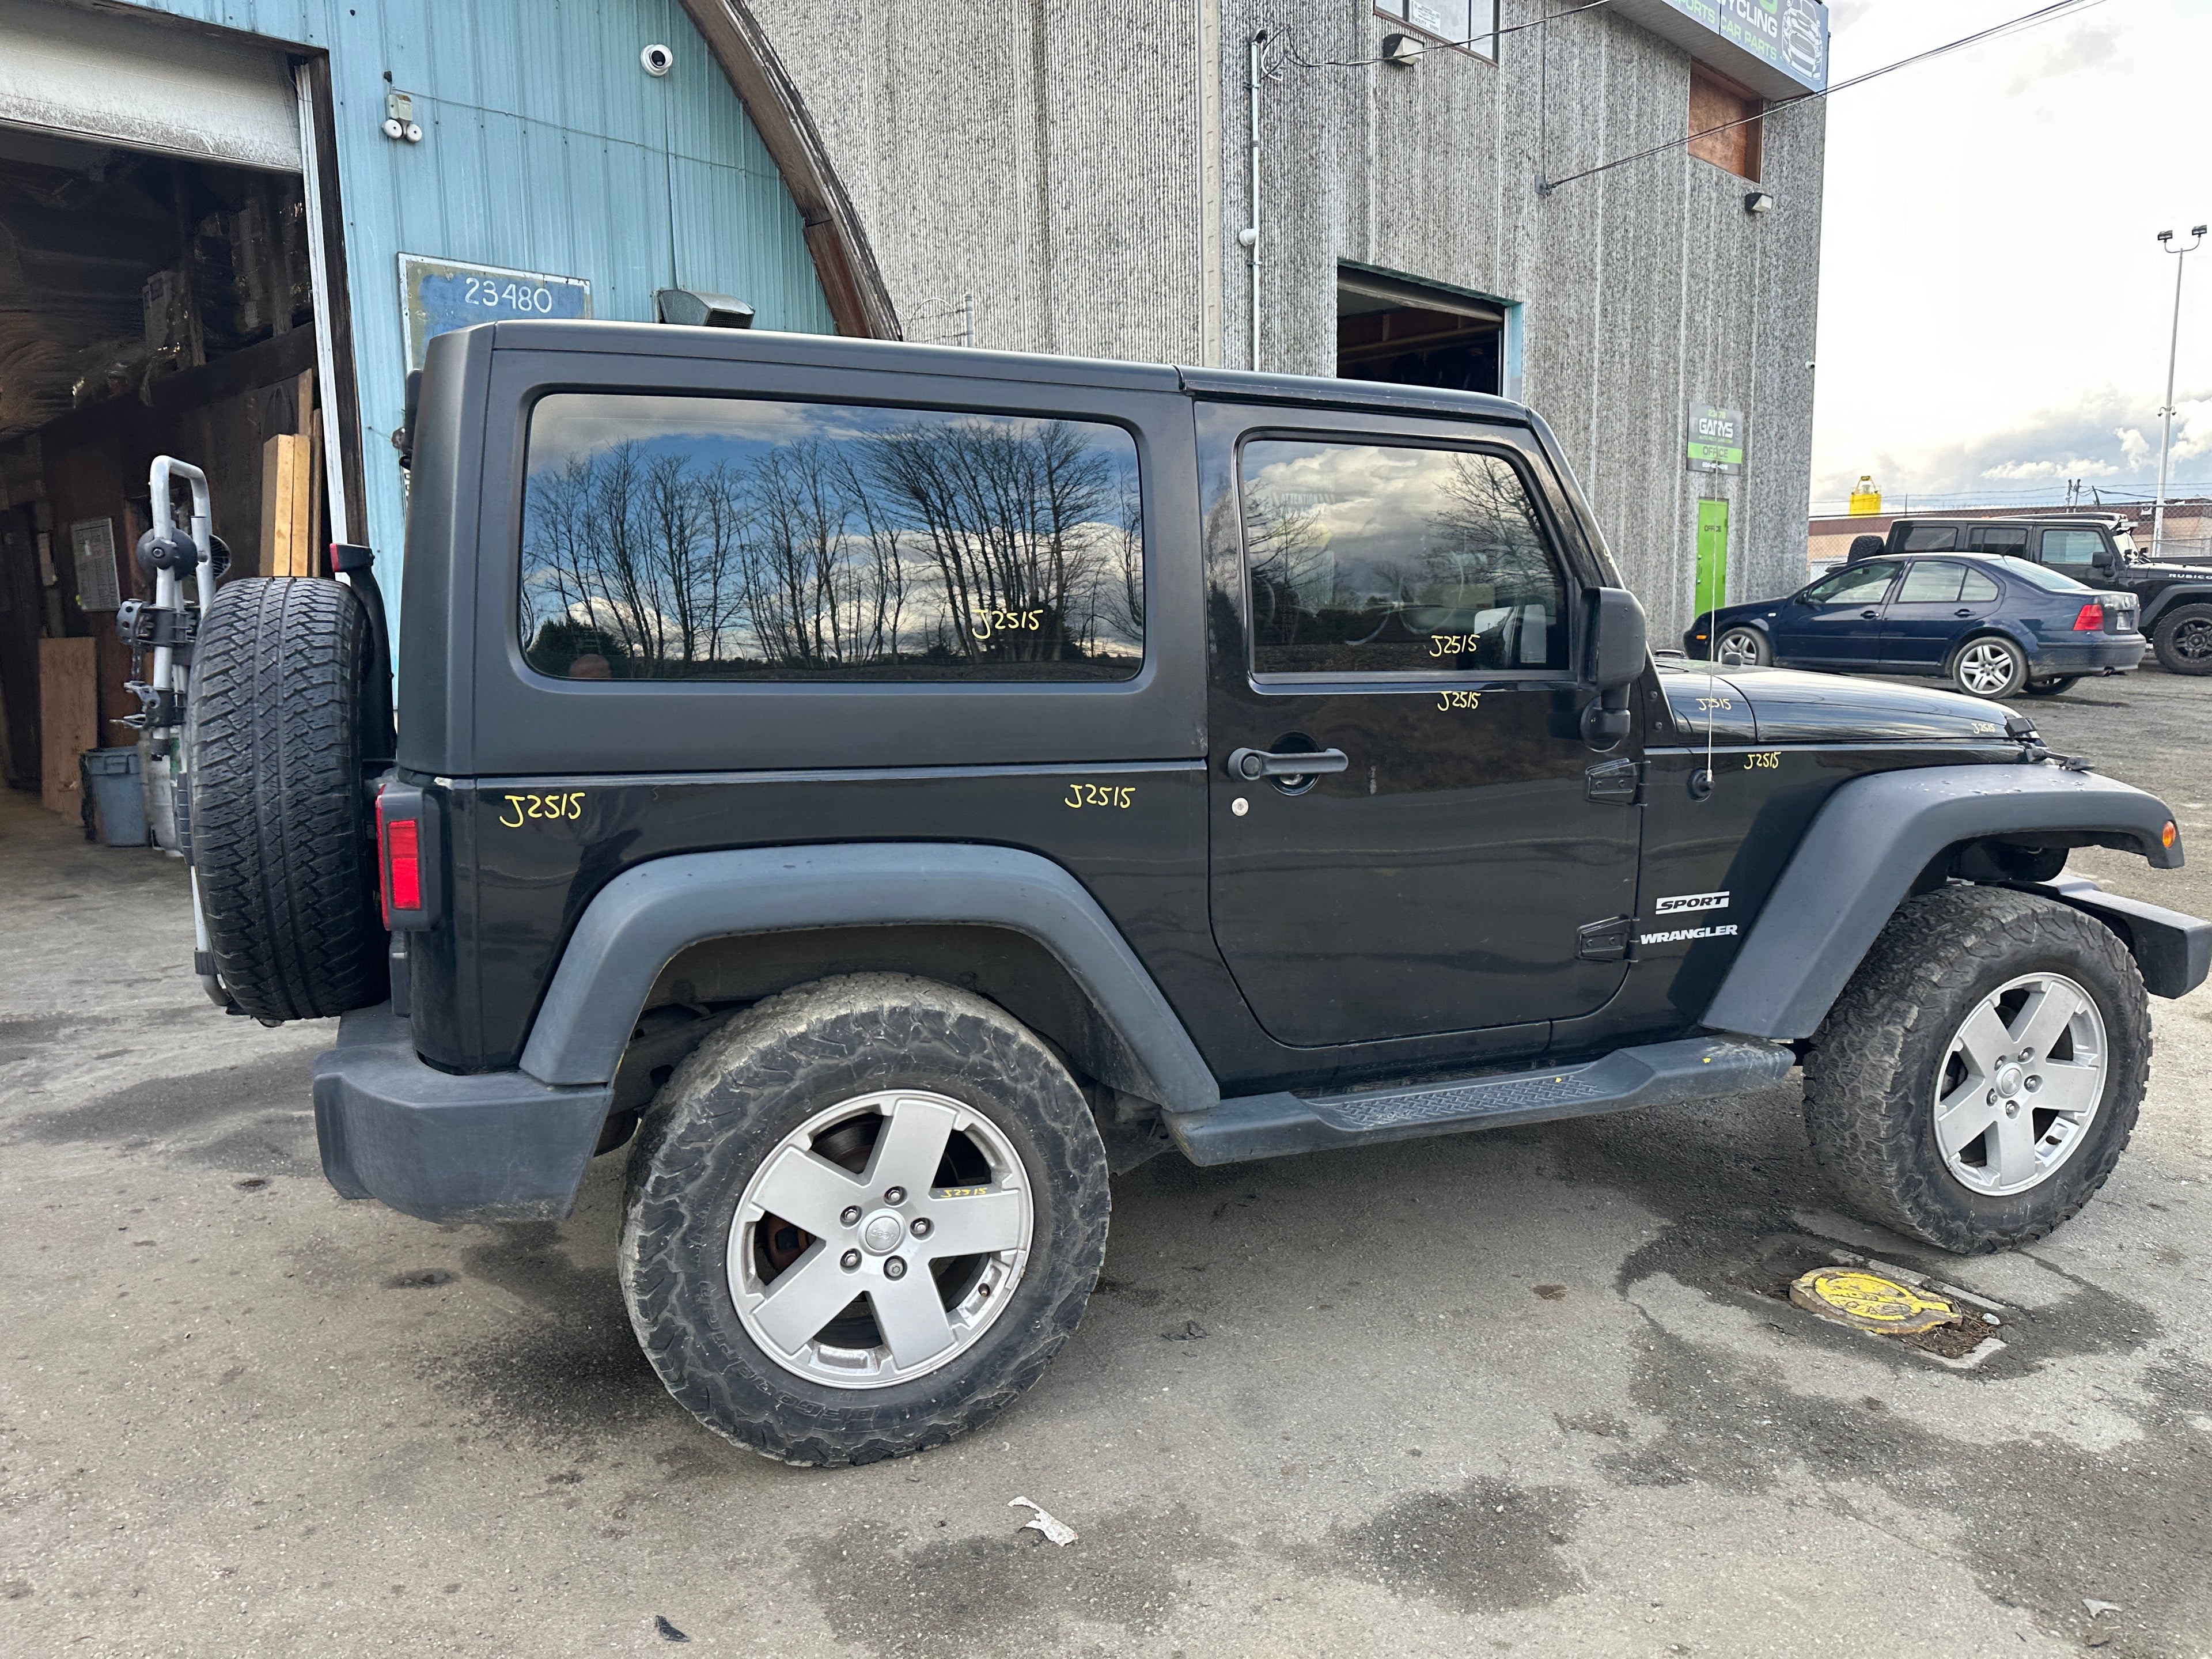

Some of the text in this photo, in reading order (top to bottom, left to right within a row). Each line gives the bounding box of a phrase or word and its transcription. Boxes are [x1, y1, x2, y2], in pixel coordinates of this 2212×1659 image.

[1719, 14, 1741, 40] CAR
[1744, 31, 1777, 61] PARTS
[464, 277, 552, 313] 23480
[971, 609, 1044, 639] J2515
[1429, 634, 1480, 657] J2515
[1437, 691, 1482, 711] J2515
[1695, 698, 1732, 711] J2515
[1971, 722, 1996, 734] J2515
[1744, 751, 1782, 770] J2515
[1065, 783, 1136, 809] J2515
[499, 792, 586, 828] J2515
[1657, 896, 1729, 911] SPORT
[1640, 924, 1738, 945] WRANGLER
